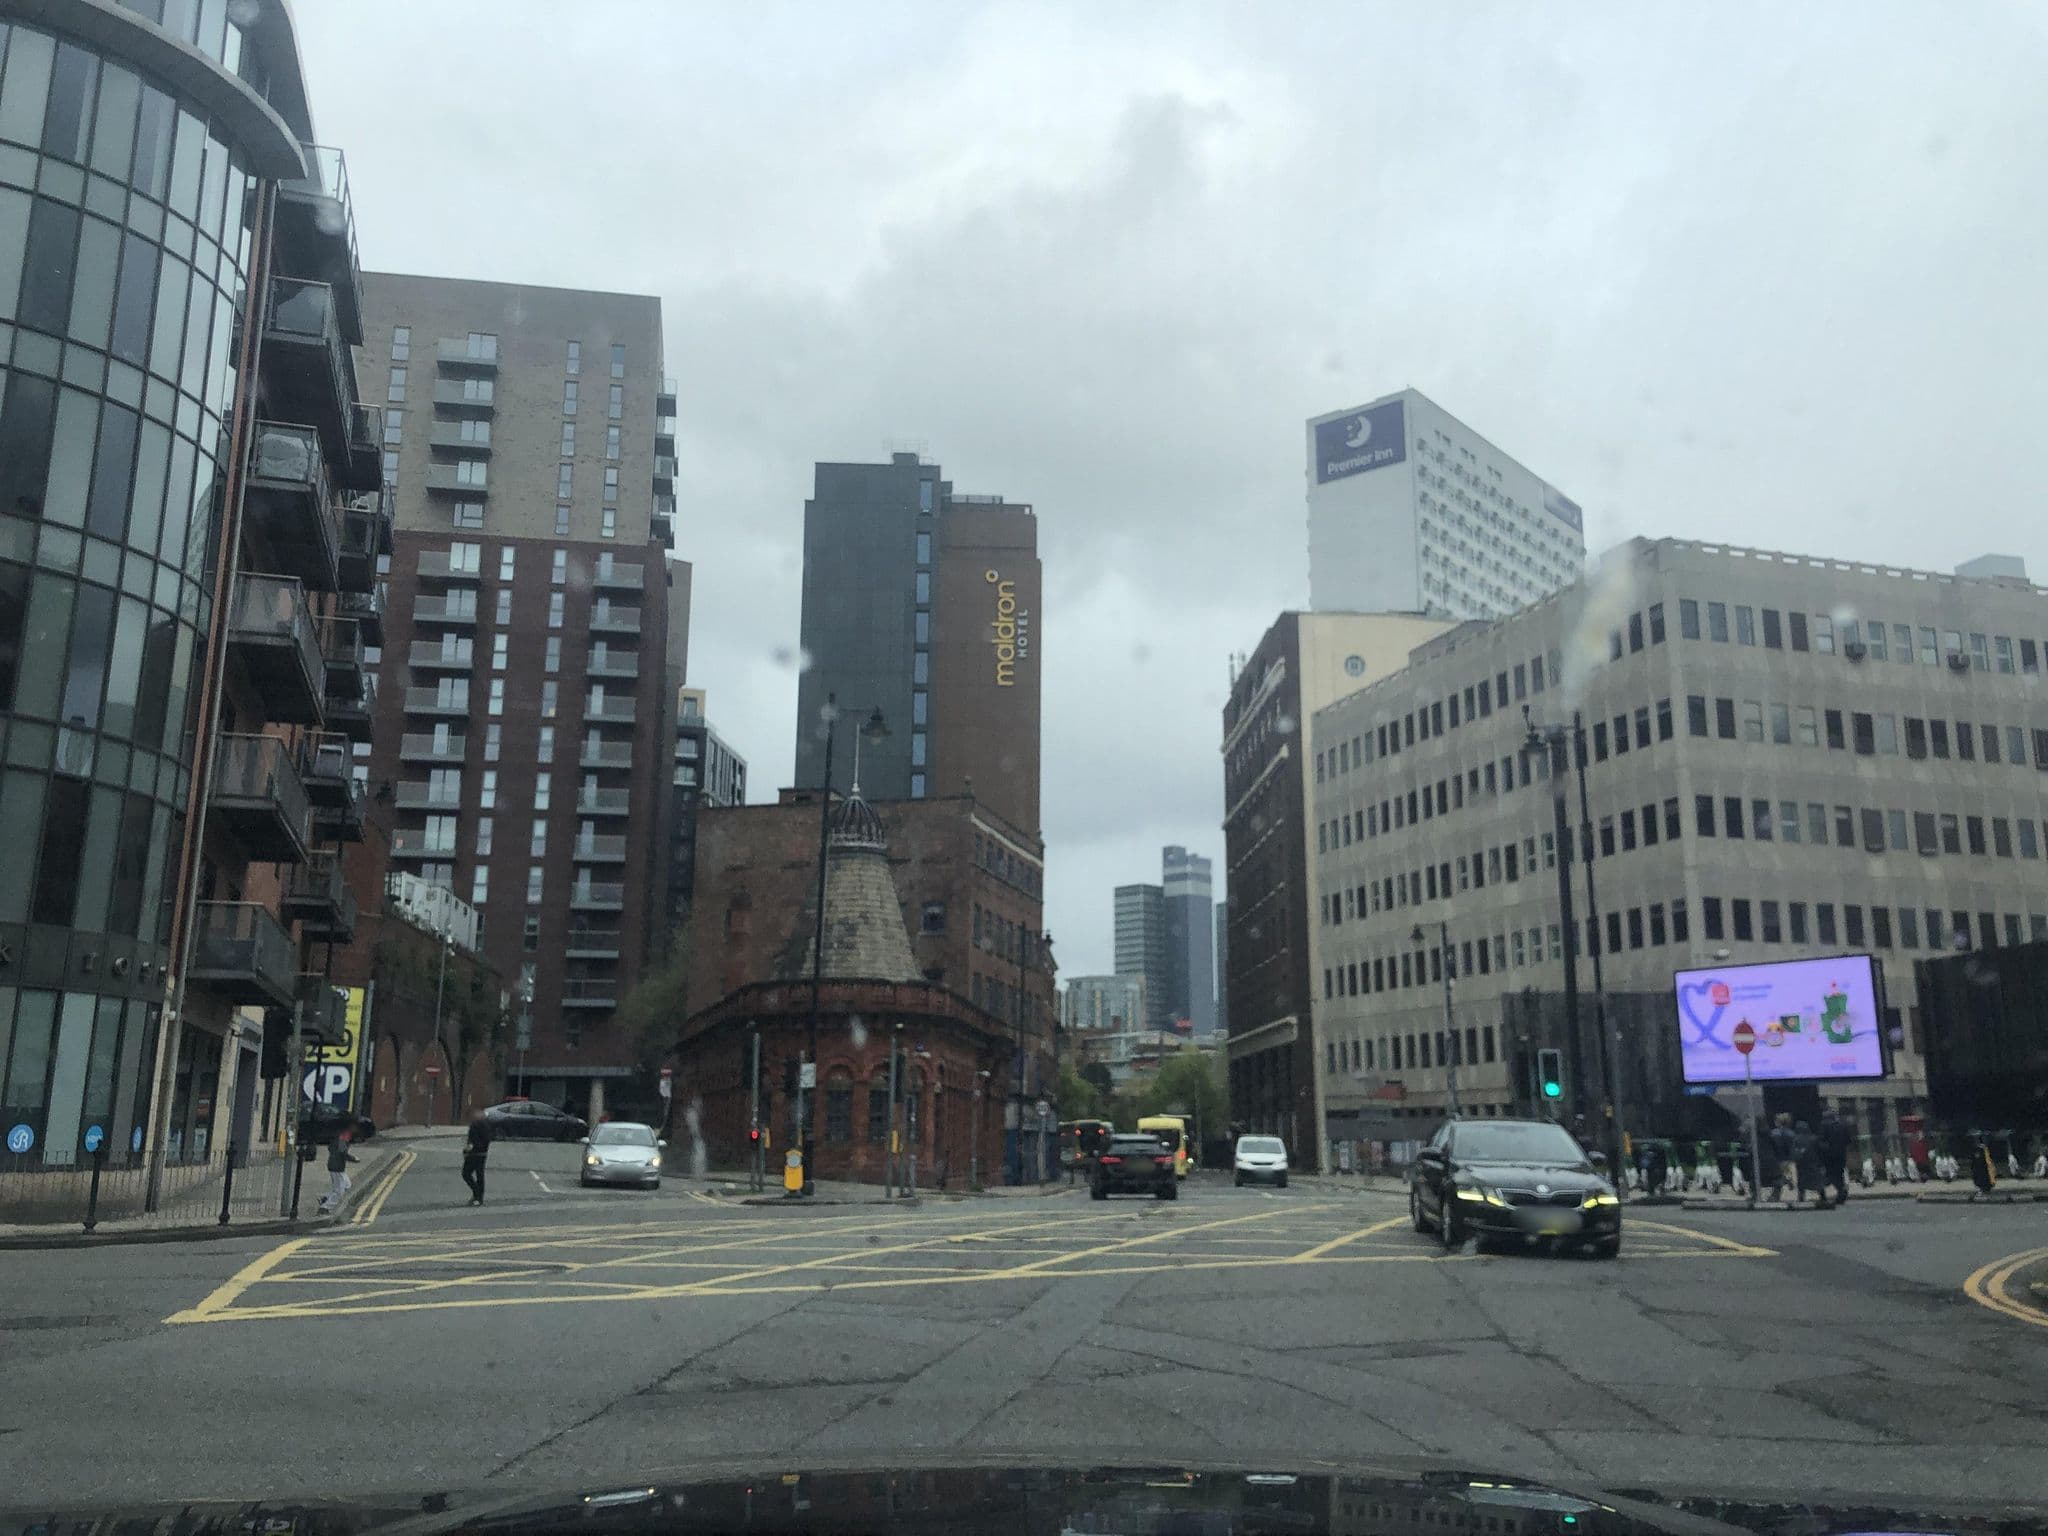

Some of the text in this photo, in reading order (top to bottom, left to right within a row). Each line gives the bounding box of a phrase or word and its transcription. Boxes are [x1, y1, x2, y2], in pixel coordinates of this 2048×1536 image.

[1327, 453, 1373, 475] Premier
[992, 580, 1016, 687] maldron
[1017, 609, 1029, 658] HOTEL
